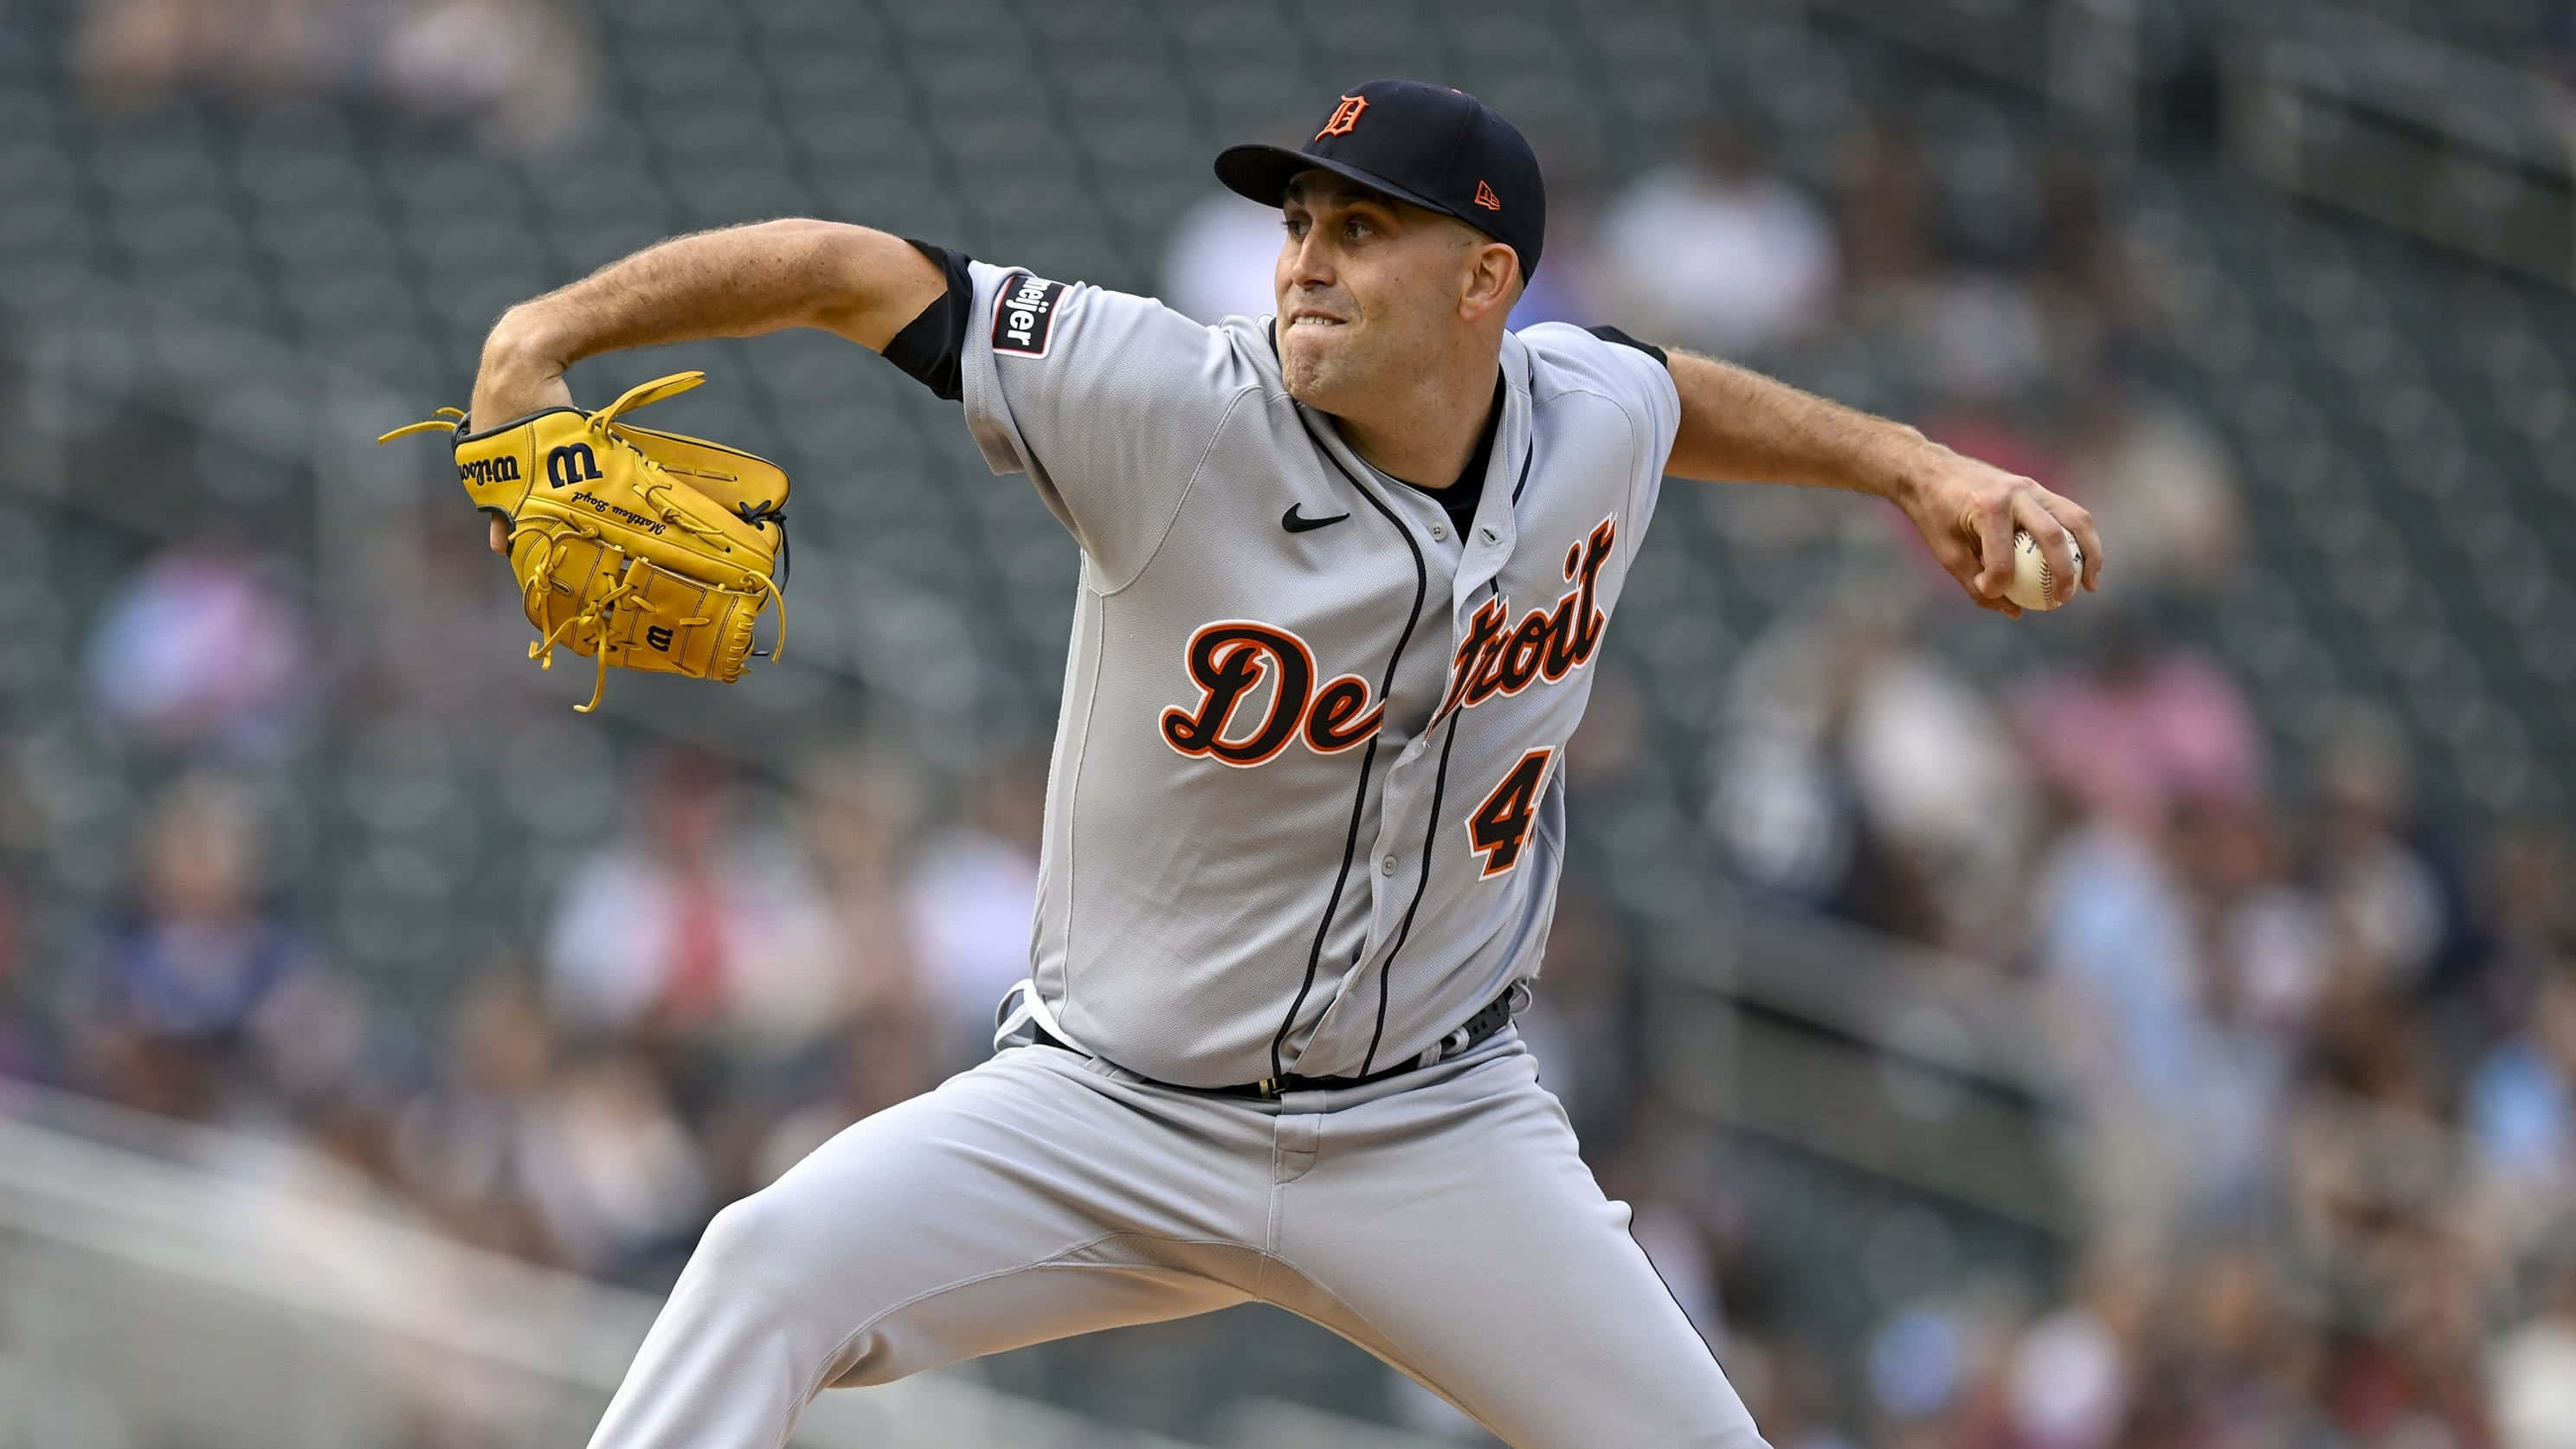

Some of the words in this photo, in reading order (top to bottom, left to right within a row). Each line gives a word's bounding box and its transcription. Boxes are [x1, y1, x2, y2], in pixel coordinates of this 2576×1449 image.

[1315, 94, 1369, 142] D
[570, 491, 609, 513] Boyd
[611, 506, 667, 536] Matthew
[1464, 745, 1556, 882] 4
